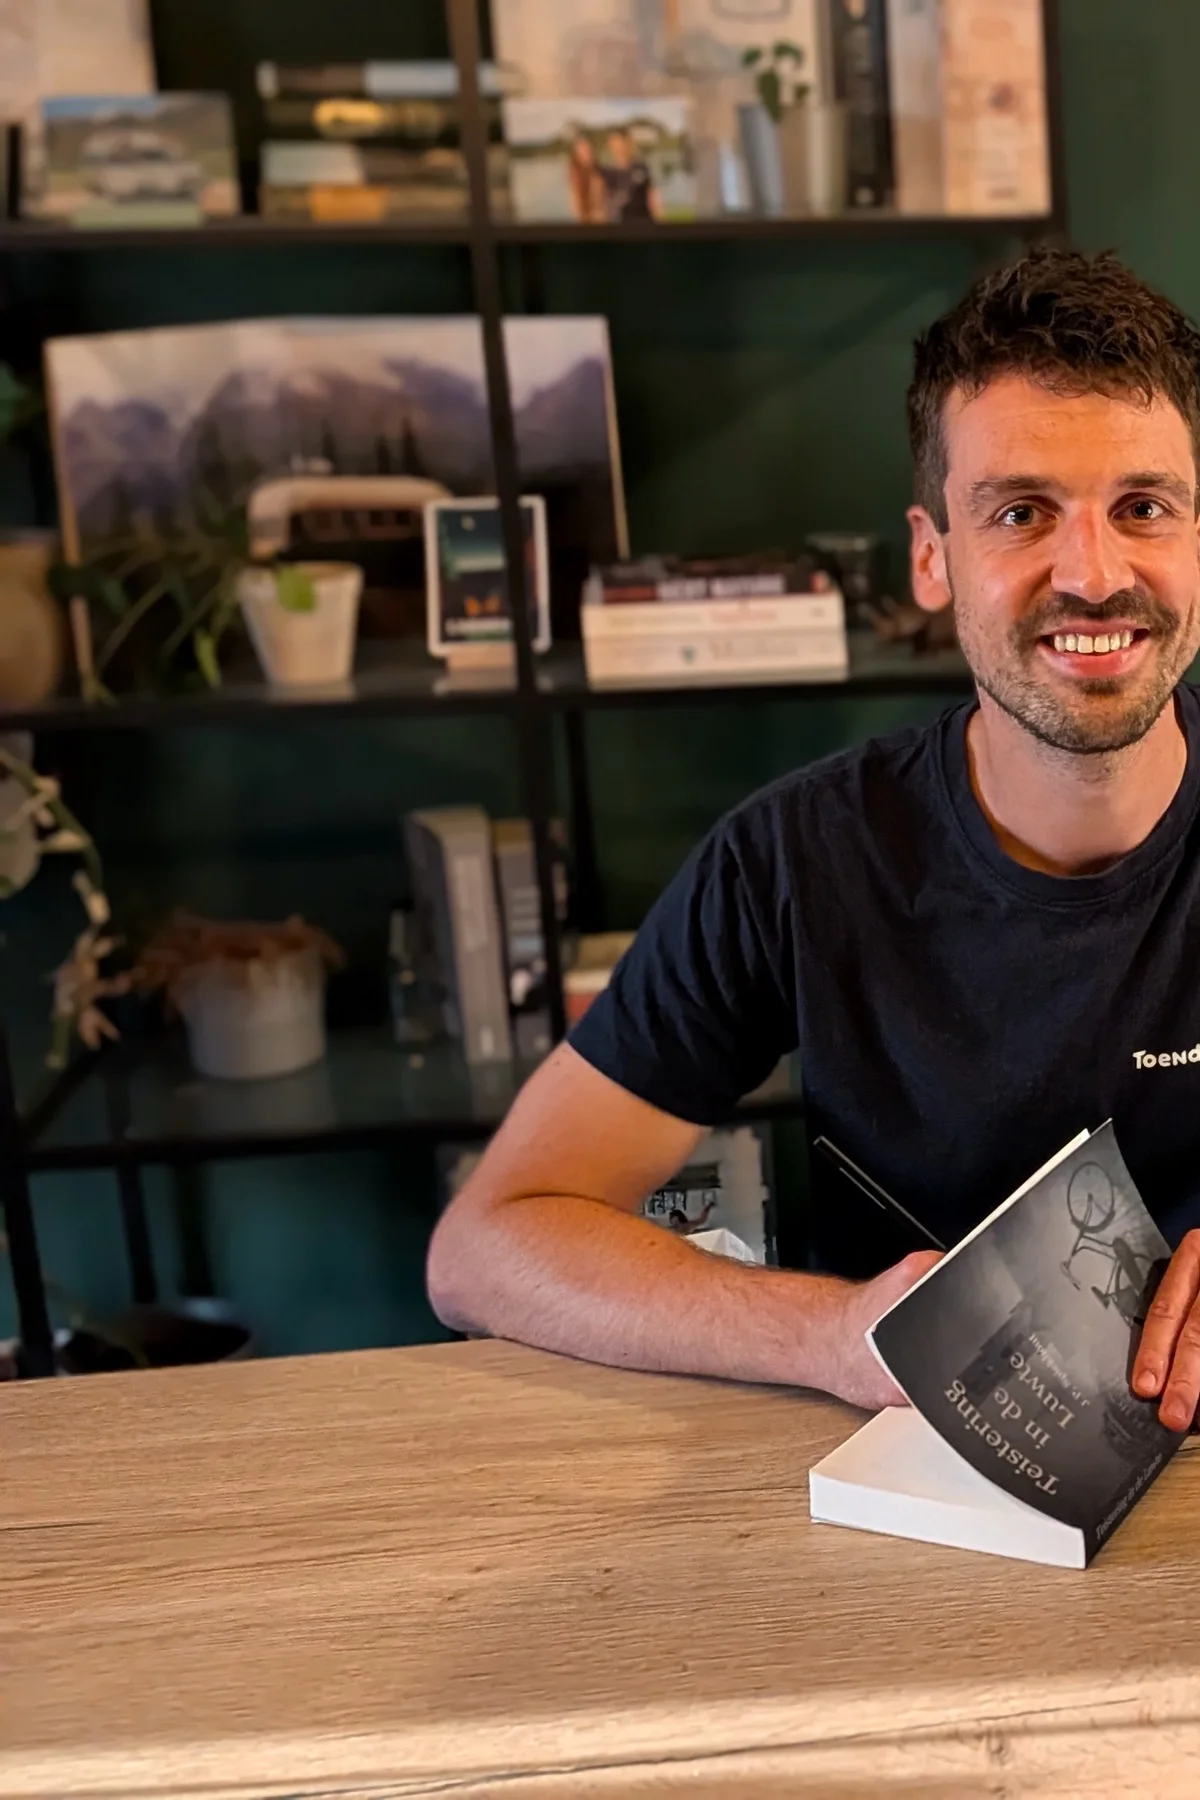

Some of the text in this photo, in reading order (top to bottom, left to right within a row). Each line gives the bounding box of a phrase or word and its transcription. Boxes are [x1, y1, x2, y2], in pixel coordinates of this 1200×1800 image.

[993, 1387, 1052, 1450] in de
[1010, 1351, 1076, 1430] Luwte
[944, 1379, 1060, 1496] Teistering
